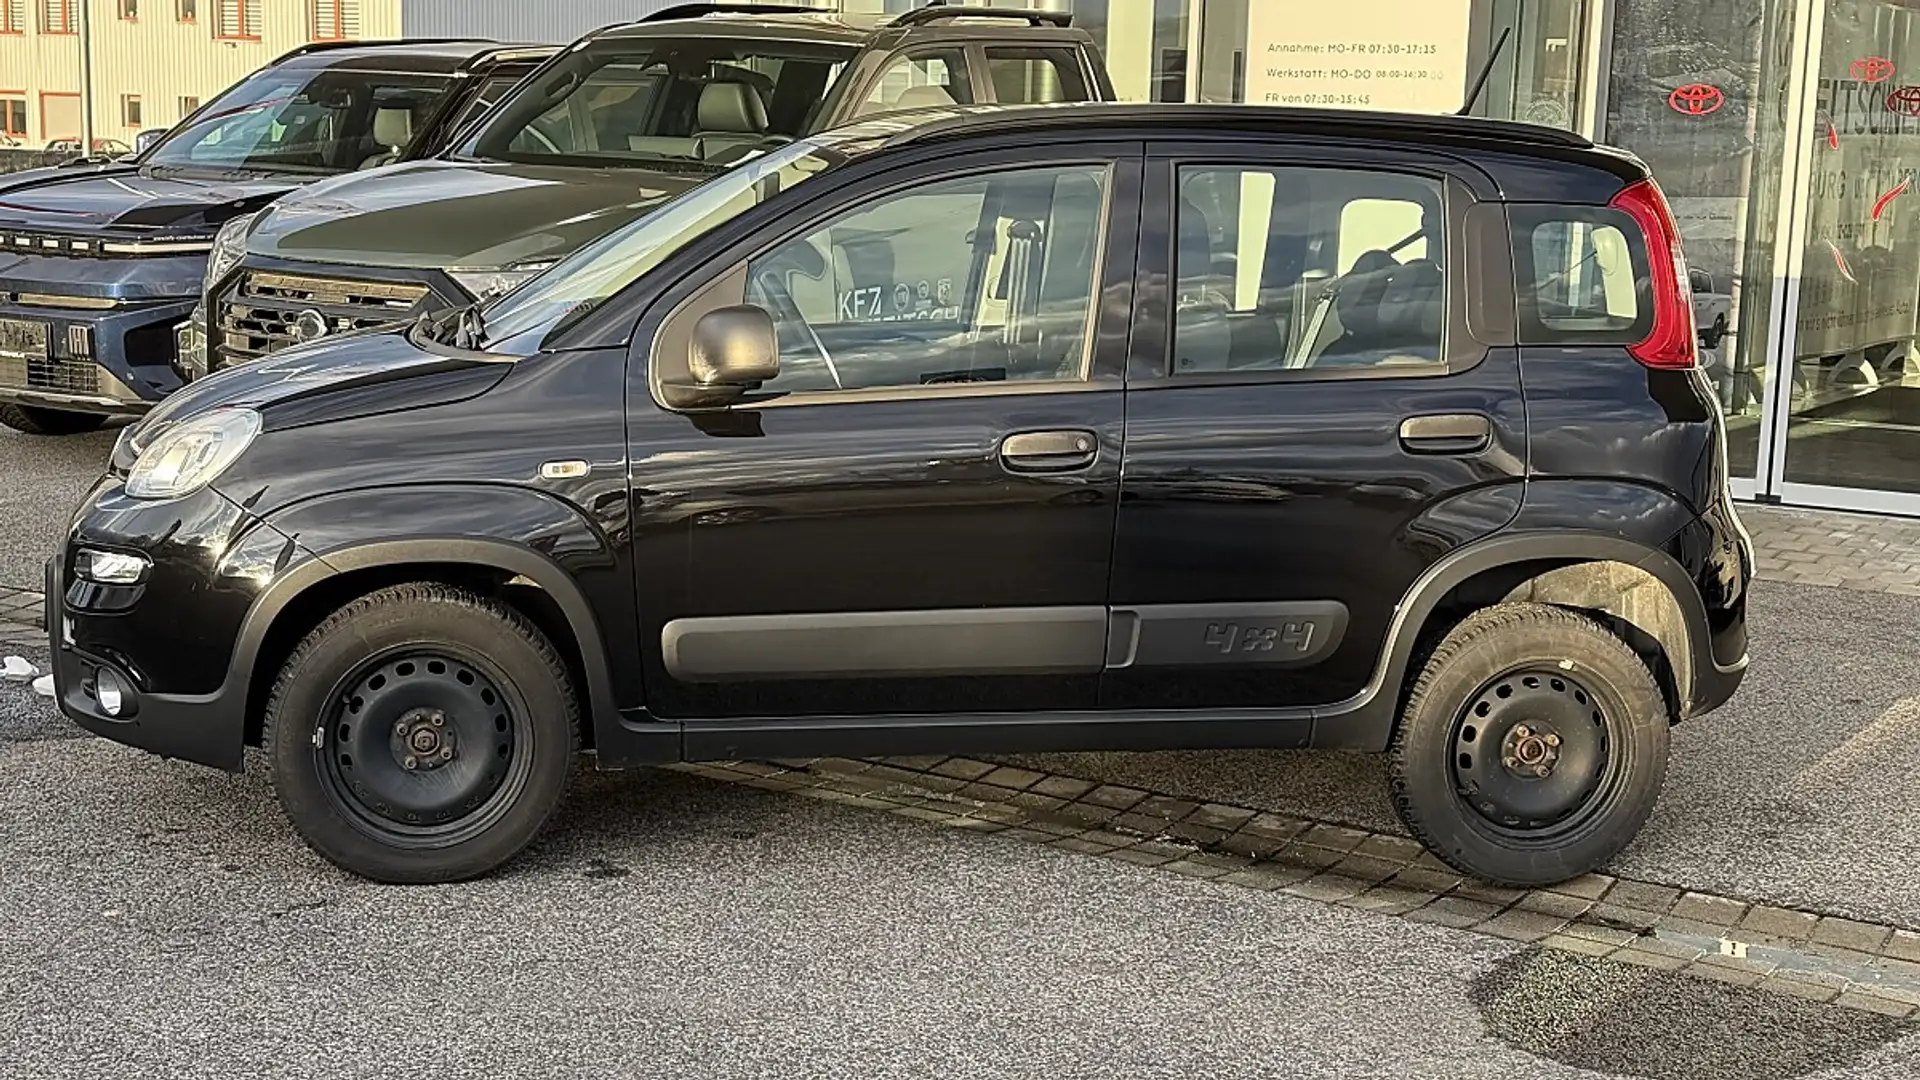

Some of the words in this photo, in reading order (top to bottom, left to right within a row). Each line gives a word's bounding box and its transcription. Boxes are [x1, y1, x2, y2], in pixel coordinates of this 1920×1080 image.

[1267, 43, 1325, 54] Annahme:
[1327, 44, 1366, 54] MO-FR
[1368, 44, 1437, 55] 07:30-17:15
[1266, 68, 1327, 79] Werkstatt:
[1330, 68, 1371, 80] MO-DO
[1265, 92, 1280, 103] FR
[1281, 94, 1302, 104] von
[1303, 94, 1371, 105] 07:30-15:45
[839, 286, 882, 321] KFZ
[1205, 622, 1315, 654] 4x4
